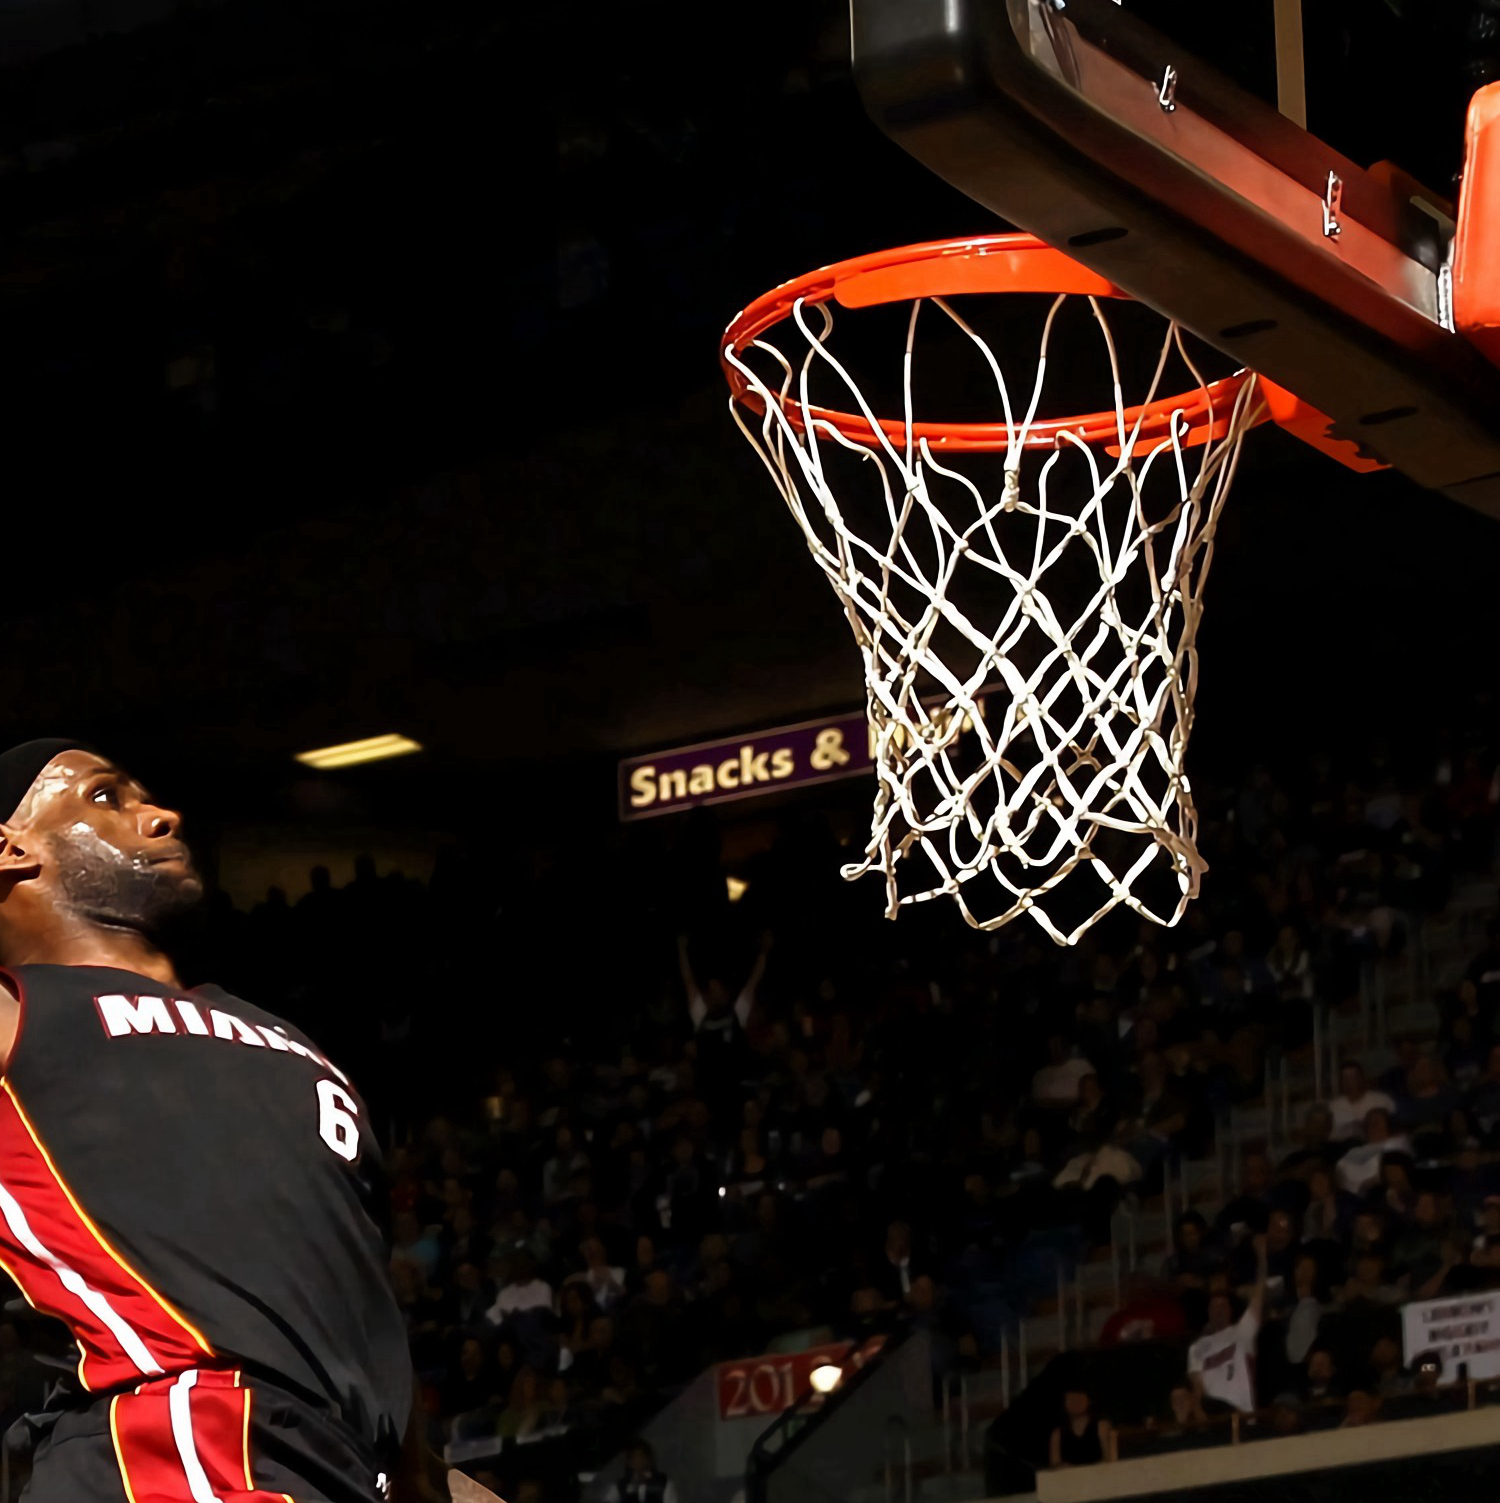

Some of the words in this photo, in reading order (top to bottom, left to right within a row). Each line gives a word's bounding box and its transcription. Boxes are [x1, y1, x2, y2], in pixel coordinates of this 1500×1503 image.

[629, 745, 794, 808] Snacks
[810, 728, 850, 771] &
[316, 1079, 360, 1162] 6
[725, 1361, 795, 1417] 201
